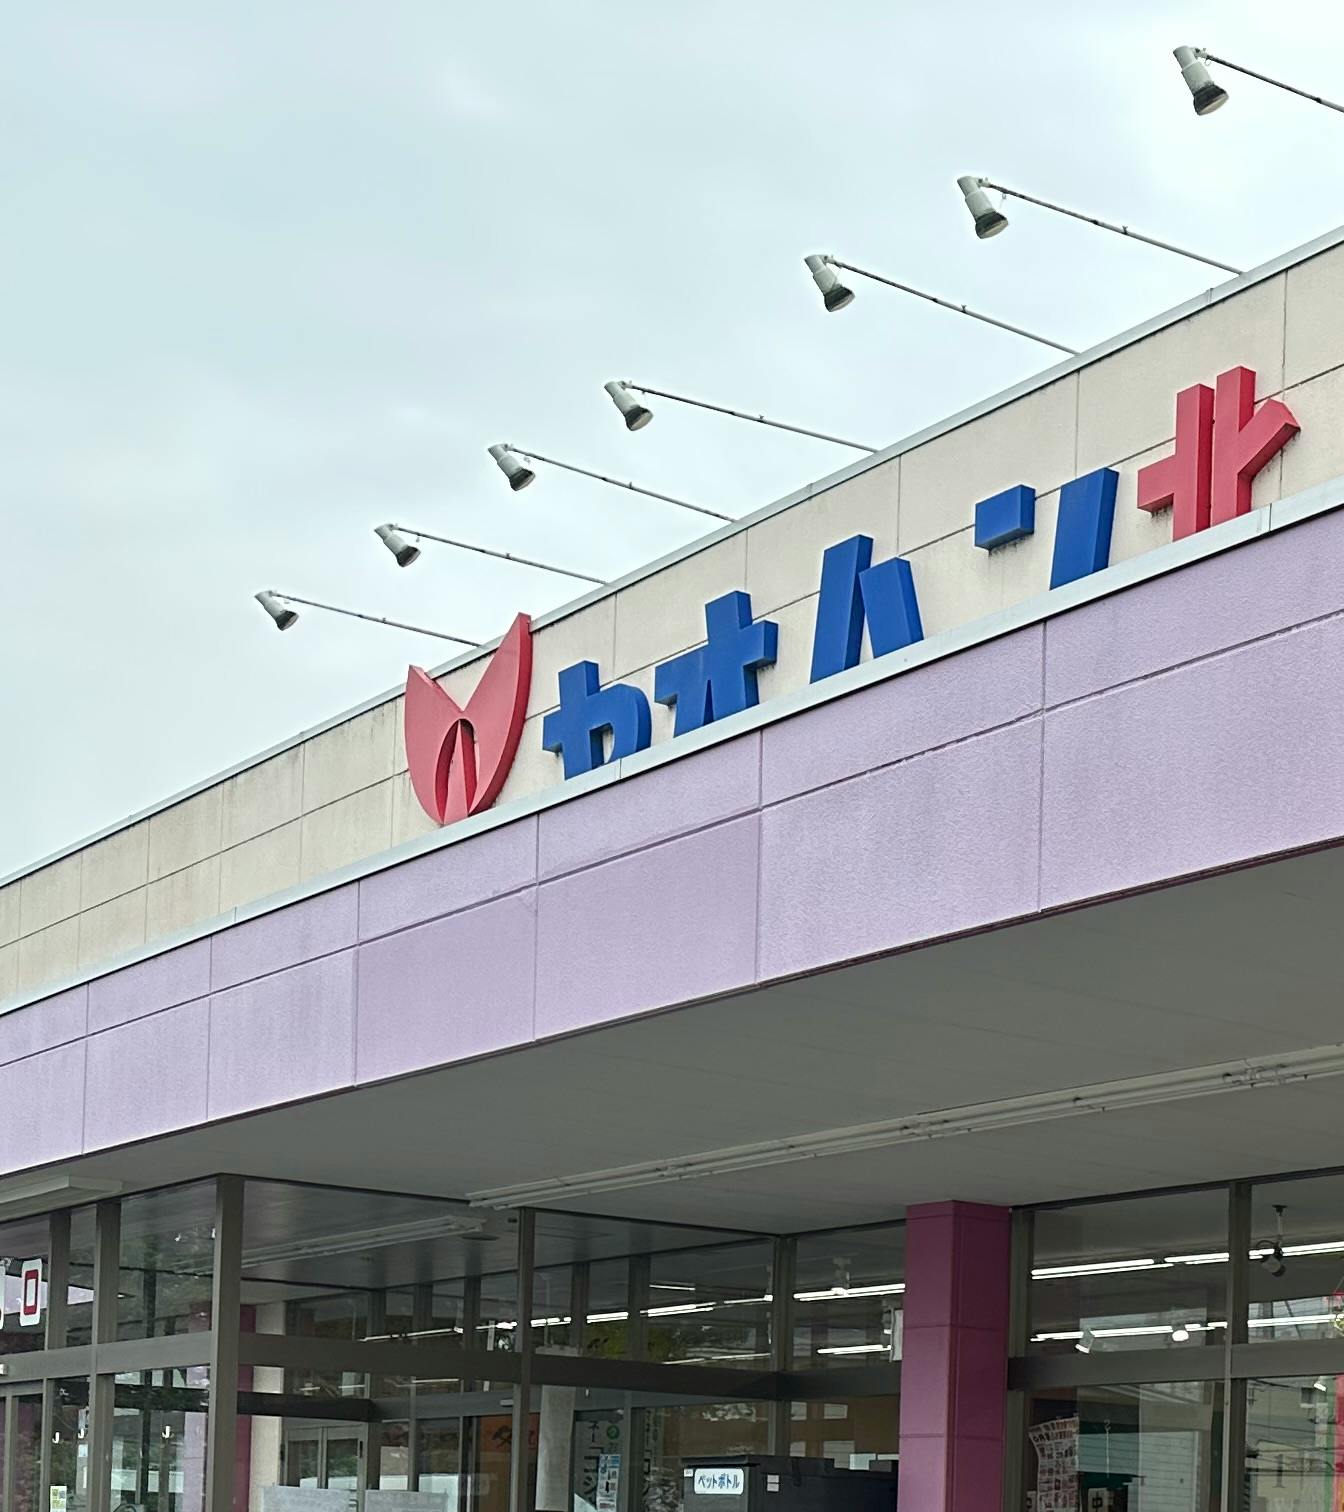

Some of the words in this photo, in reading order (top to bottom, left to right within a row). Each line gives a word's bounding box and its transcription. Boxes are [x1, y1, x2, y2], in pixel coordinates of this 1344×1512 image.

[697, 1472, 740, 1489] ペットボトル
